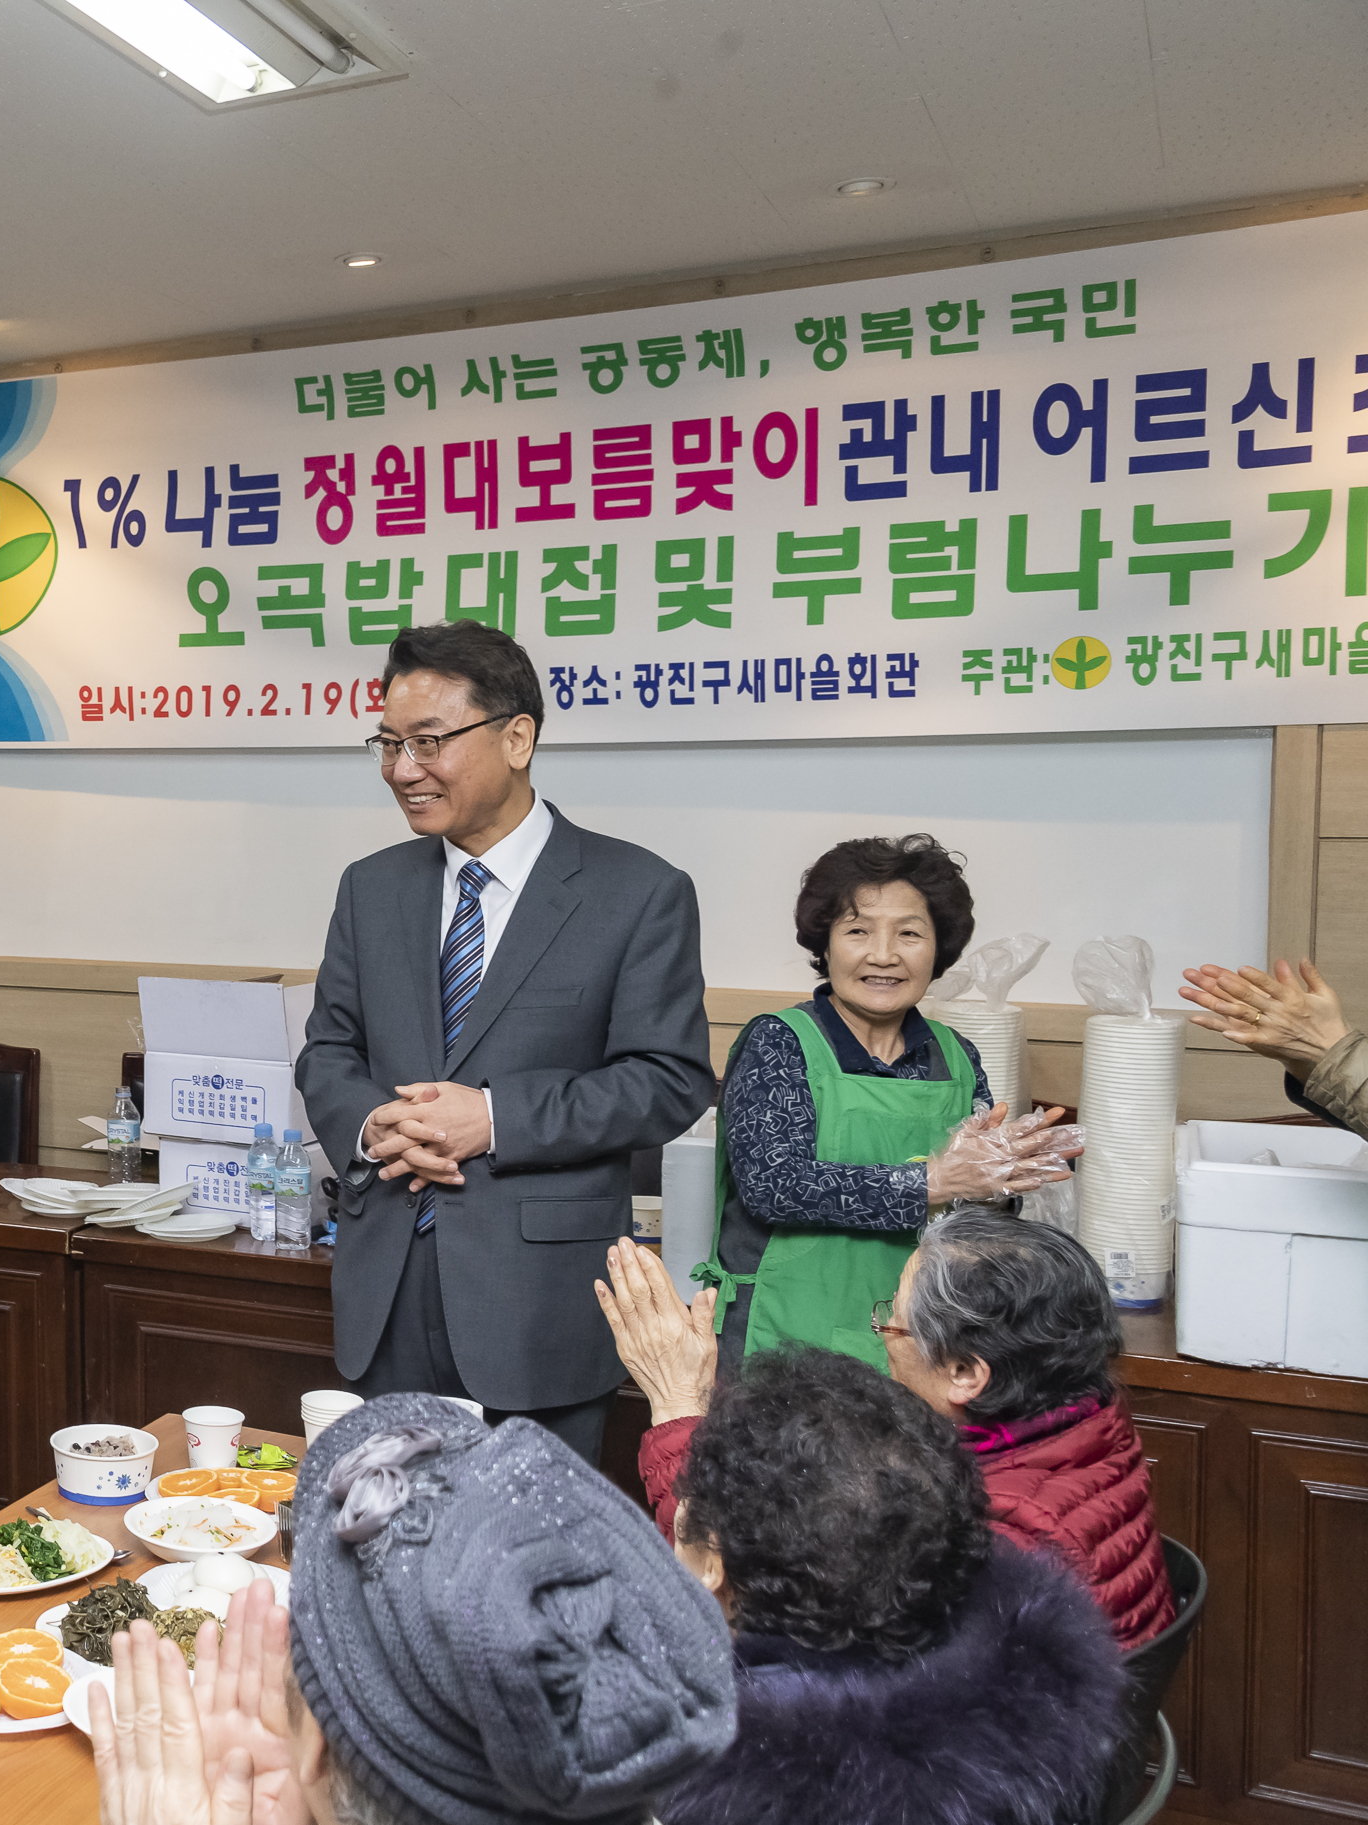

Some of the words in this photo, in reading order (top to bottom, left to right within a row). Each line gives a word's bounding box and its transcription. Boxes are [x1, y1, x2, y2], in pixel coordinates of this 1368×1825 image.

[294, 363, 437, 421] 더불어
[460, 353, 558, 404] 사는
[580, 328, 770, 395] 공동체,
[794, 299, 986, 372] 행복한
[1010, 278, 1137, 343] 국민
[63, 473, 147, 549] 1%
[164, 463, 281, 549] 나눔
[1032, 356, 1316, 484] 어르신
[178, 557, 425, 648] 오곡밥
[444, 543, 618, 640] 대접
[653, 535, 735, 632] 및
[771, 485, 1368, 626] 부럼나누기
[961, 647, 1050, 696] 주관:
